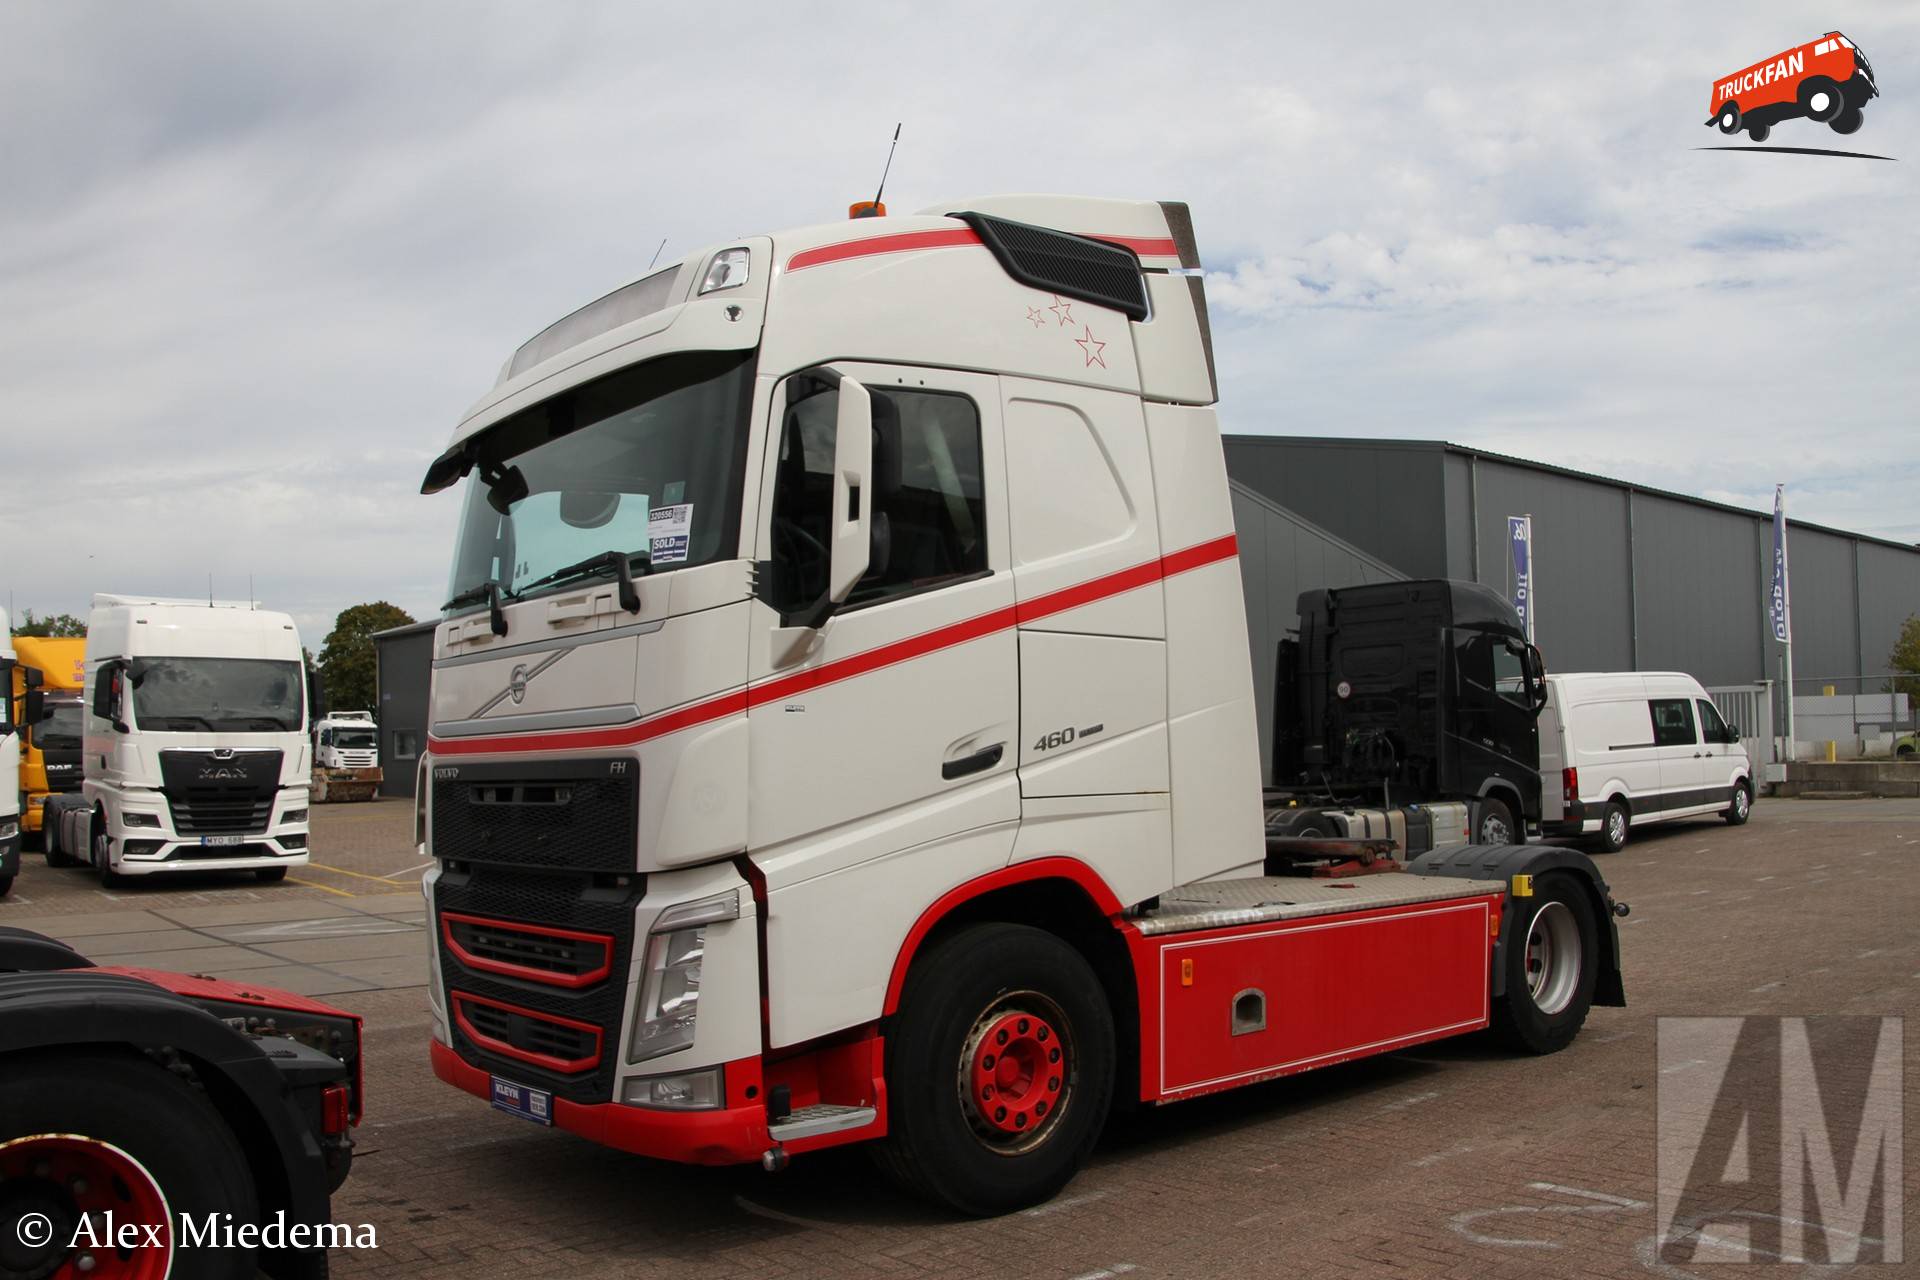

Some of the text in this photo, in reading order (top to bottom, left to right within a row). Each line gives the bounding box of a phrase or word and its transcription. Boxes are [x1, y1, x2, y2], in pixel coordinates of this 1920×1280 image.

[654, 537, 675, 549] SOLD
[1033, 727, 1075, 752] 460
[199, 768, 248, 778] MAN
[434, 762, 626, 779] VOLVO FH
[495, 1083, 519, 1100] KLEYN
